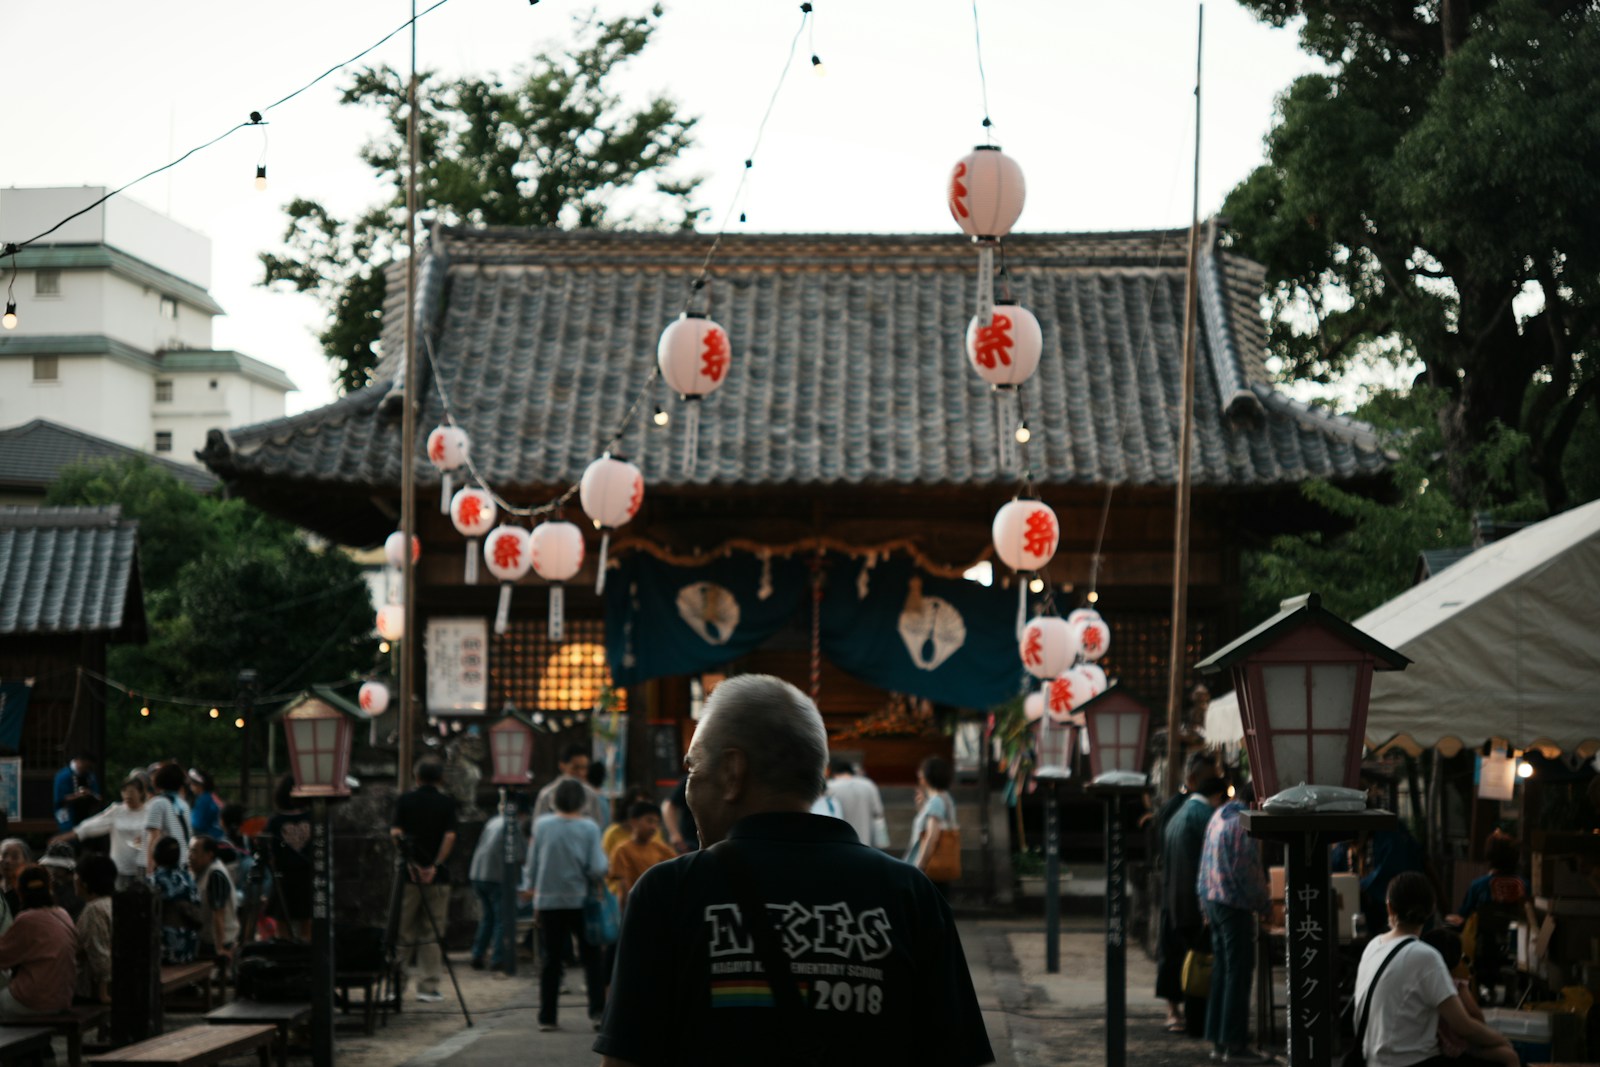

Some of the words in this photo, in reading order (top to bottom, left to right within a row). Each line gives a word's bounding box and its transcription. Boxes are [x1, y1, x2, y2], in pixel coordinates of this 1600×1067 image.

[701, 327, 731, 383] 祭
[493, 533, 522, 570] 祭
[1022, 509, 1057, 560] 祭
[814, 979, 884, 1016] 2018
[1295, 883, 1324, 1061] 中央タクシー
